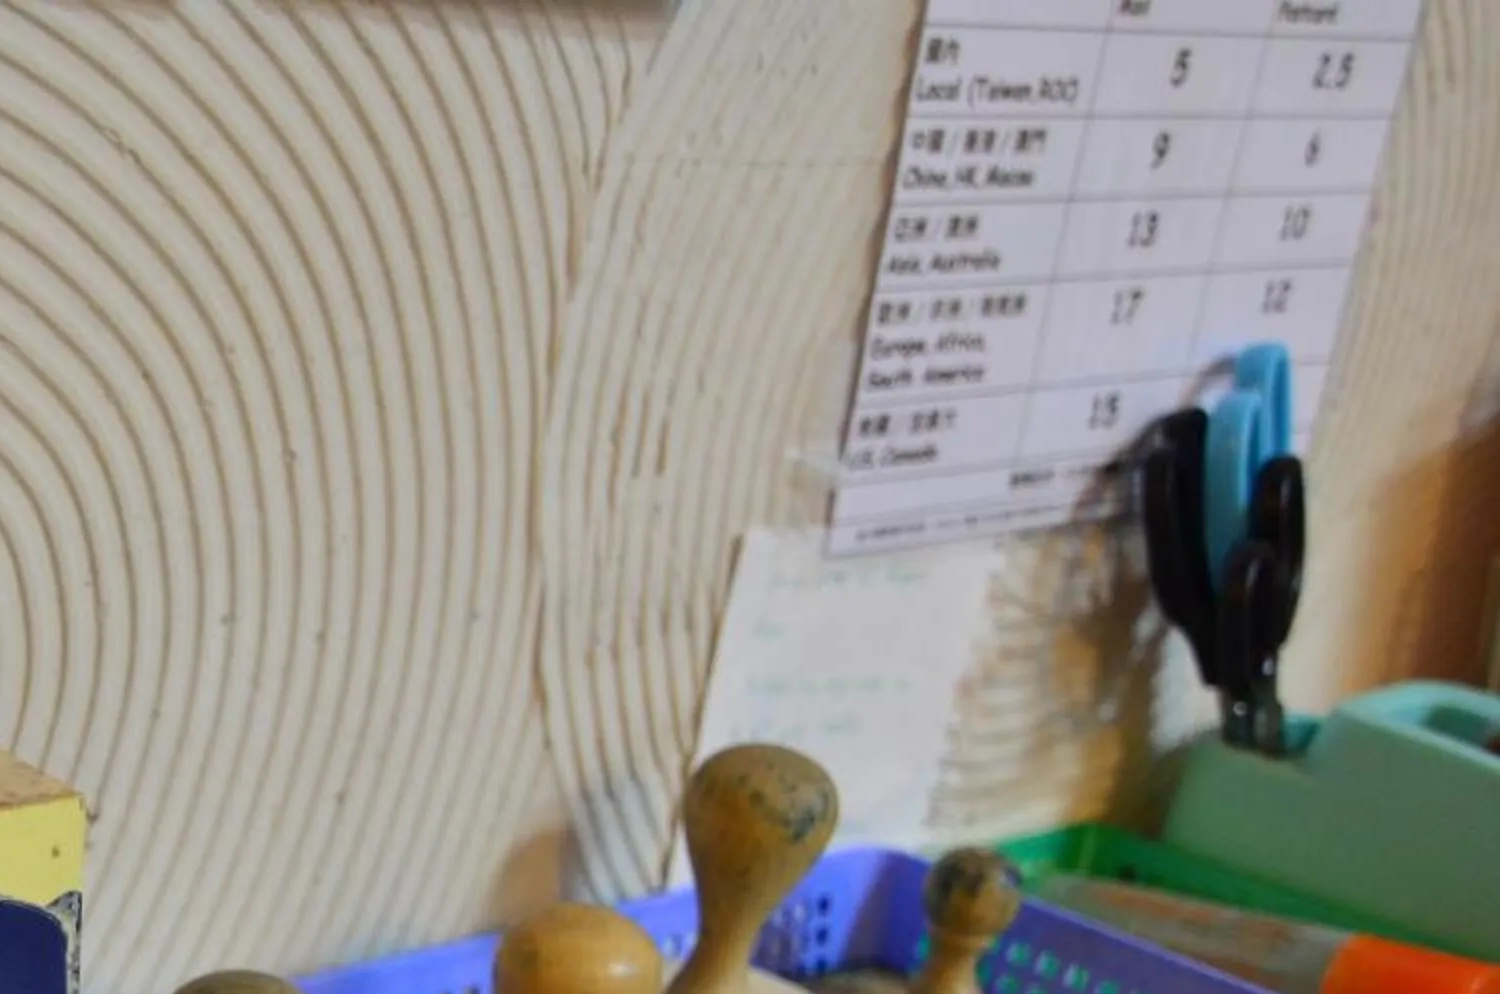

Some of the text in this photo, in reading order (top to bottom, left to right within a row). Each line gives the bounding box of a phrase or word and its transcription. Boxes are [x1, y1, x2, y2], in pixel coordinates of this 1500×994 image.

[1168, 46, 1193, 89] 5
[1310, 50, 1355, 91] 2.5
[1150, 130, 1172, 170] 9
[1126, 208, 1160, 249] 13
[1278, 202, 1312, 242] 10
[1109, 286, 1145, 327] 17
[1261, 277, 1295, 316] 12
[1086, 389, 1122, 431] 15
